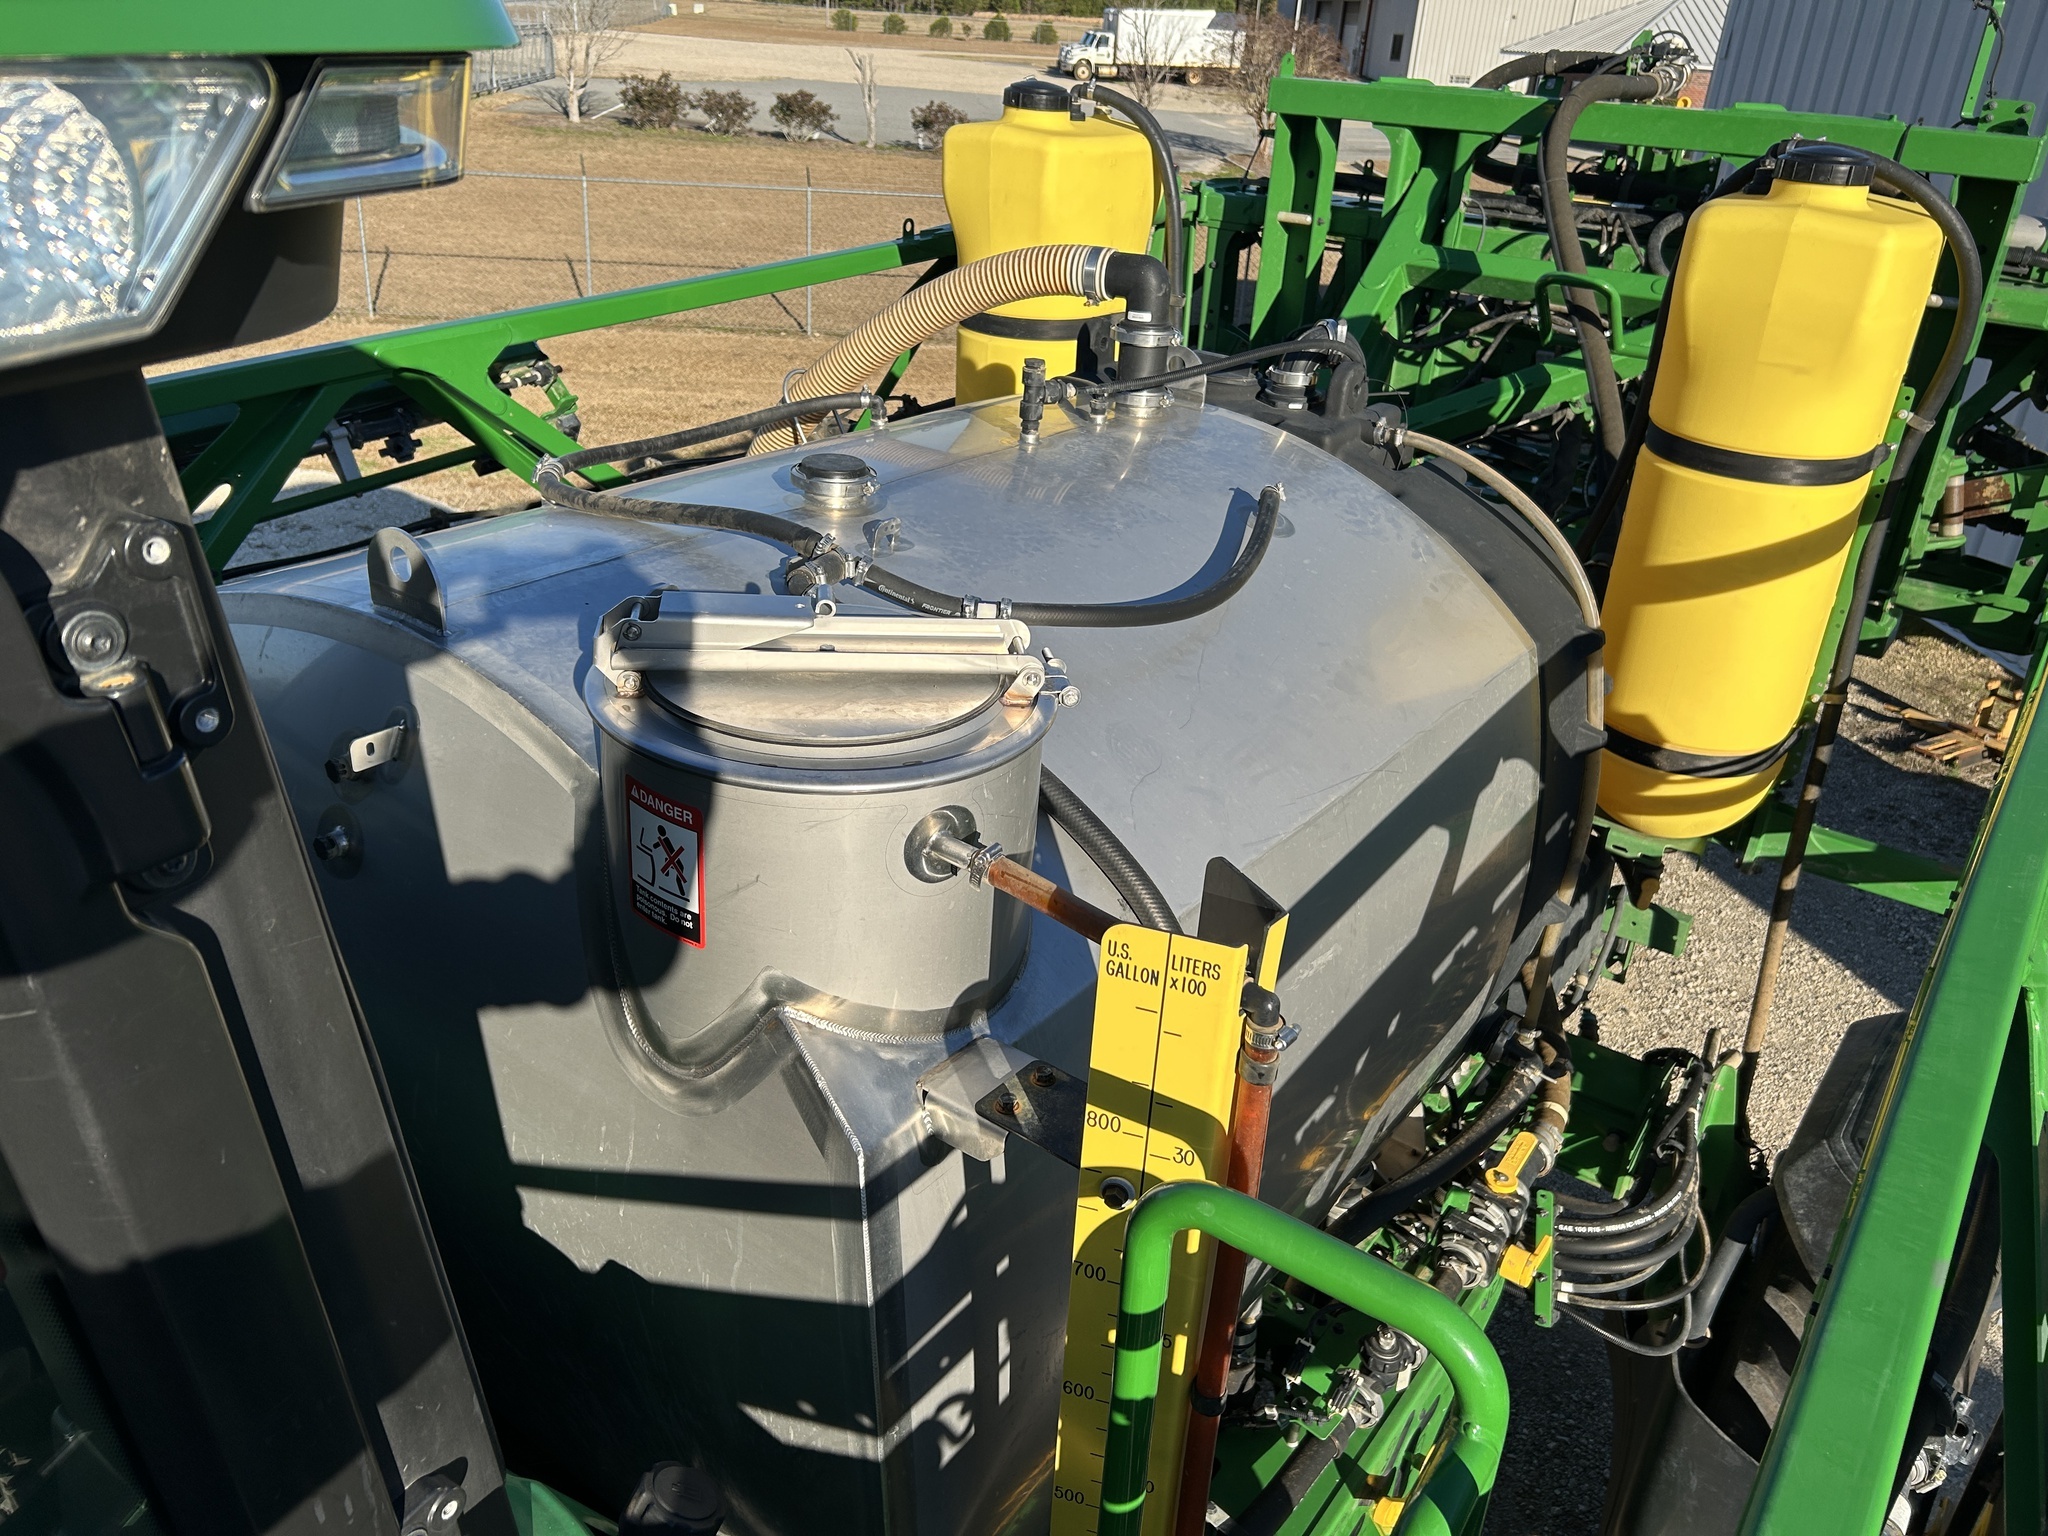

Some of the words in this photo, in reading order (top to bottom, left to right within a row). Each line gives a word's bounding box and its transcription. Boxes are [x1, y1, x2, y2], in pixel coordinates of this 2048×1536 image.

[878, 584, 911, 603] Continental
[921, 602, 952, 616] FRONTIER
[639, 786, 693, 825] DANGER
[635, 883, 650, 900] Tank
[650, 896, 679, 915] contents
[680, 911, 692, 921] are
[636, 894, 668, 918] poisonous.
[670, 913, 680, 923] Do
[681, 918, 694, 930] not
[636, 902, 651, 915] enter
[651, 911, 668, 925] tank.
[1107, 939, 1133, 961] U.S.
[1106, 959, 1160, 987] GALLON
[1171, 954, 1221, 981] LITERS
[1086, 1110, 1121, 1133] 800
[1172, 1146, 1195, 1167] 30
[1654, 1204, 1668, 1217] MADE
[1073, 1260, 1106, 1282] 700
[1162, 1333, 1172, 1349] 5
[1062, 1380, 1095, 1401] 600
[1054, 1486, 1085, 1505] 500
[1145, 1480, 1155, 1494] 0
